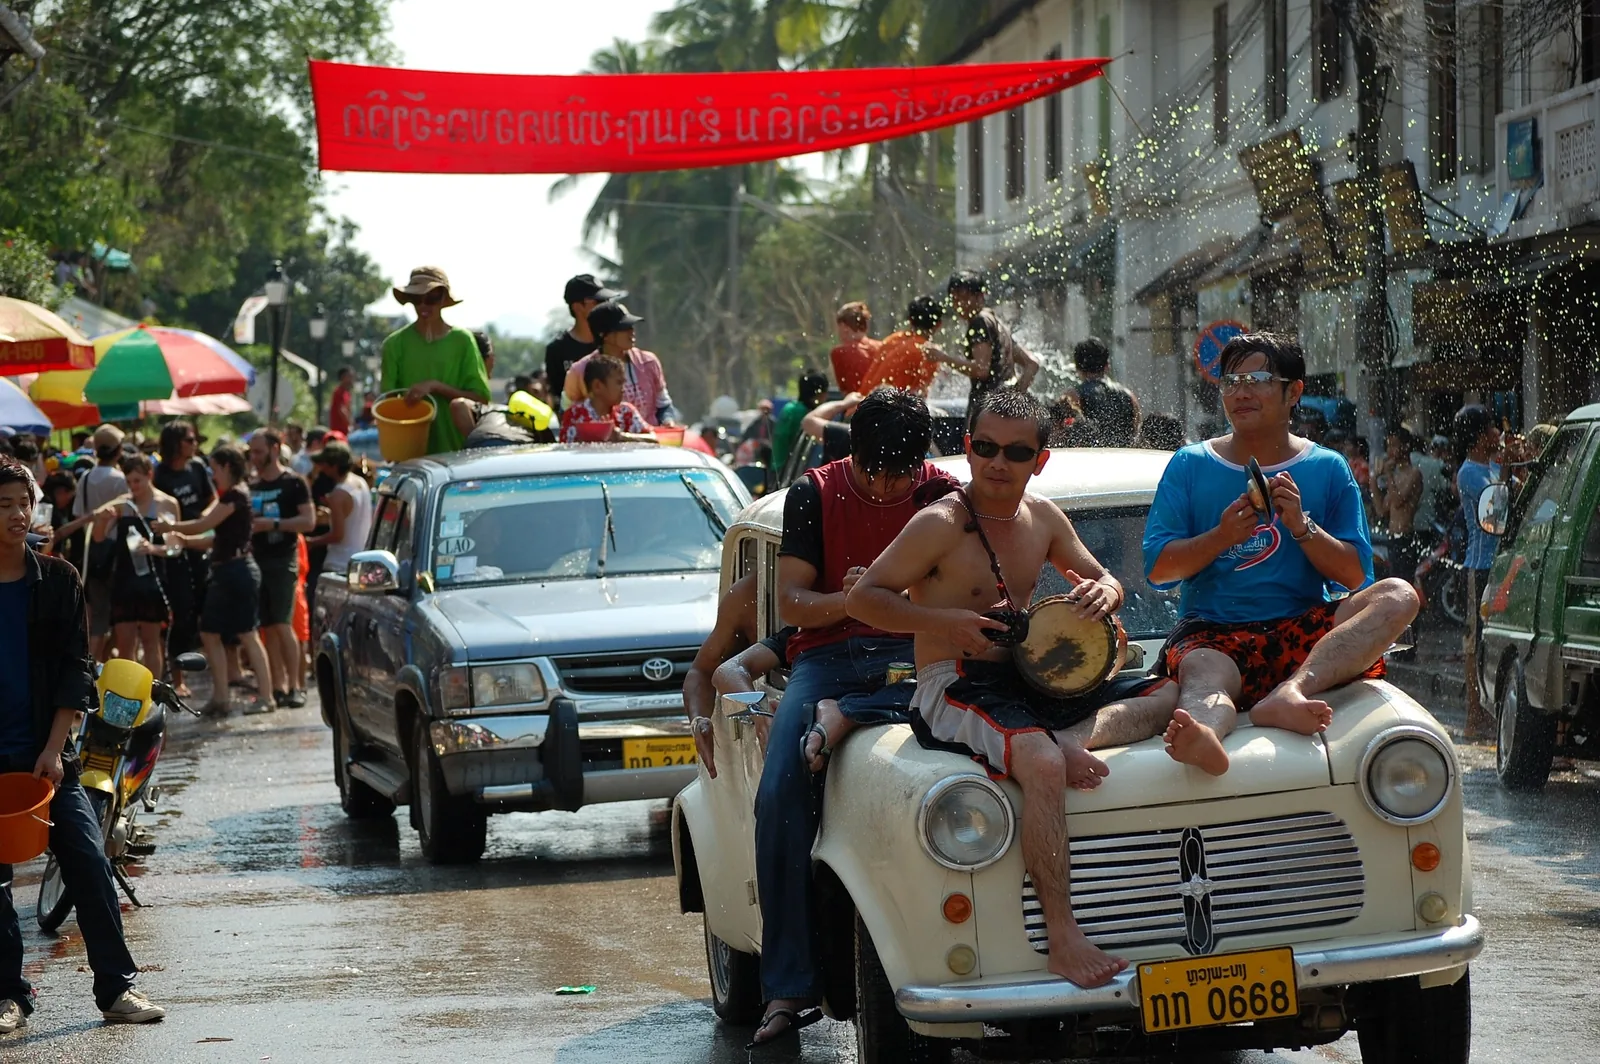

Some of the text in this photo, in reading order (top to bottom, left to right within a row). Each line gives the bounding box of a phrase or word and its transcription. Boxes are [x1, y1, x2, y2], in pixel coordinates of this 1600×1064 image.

[445, 538, 470, 554] LAO
[1150, 980, 1290, 1028] ກກ 0668
